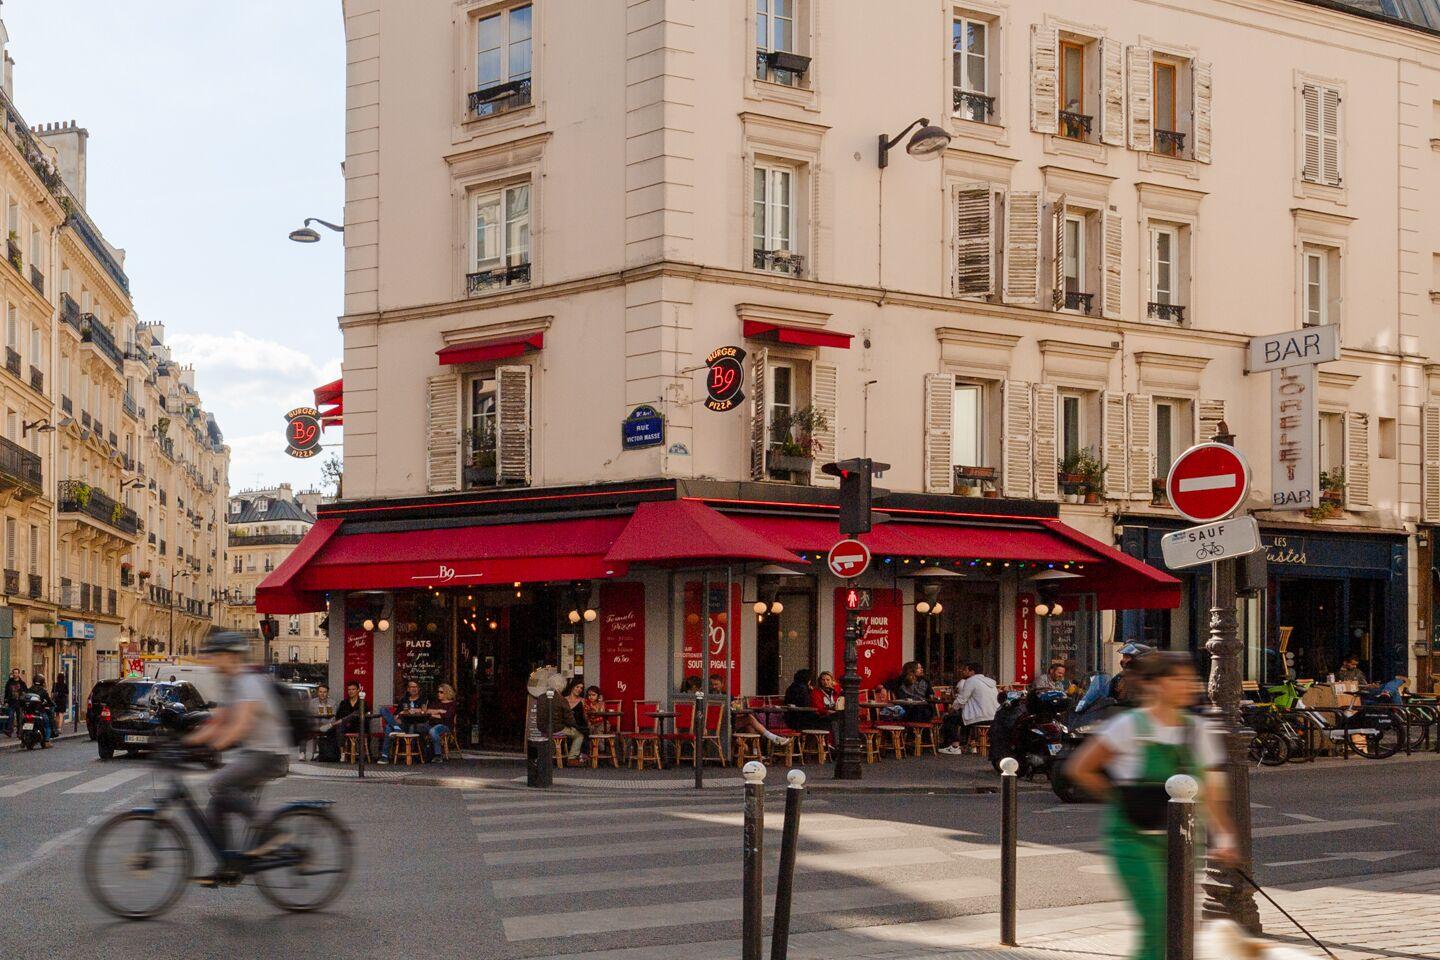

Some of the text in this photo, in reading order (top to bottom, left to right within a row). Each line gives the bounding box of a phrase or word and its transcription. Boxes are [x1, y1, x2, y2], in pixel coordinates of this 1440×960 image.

[1265, 333, 1320, 363] BAR
[707, 347, 737, 362] BURGER
[711, 366, 735, 394] B9
[709, 400, 732, 410] PIZZA
[288, 407, 317, 418] BURGER
[291, 421, 317, 444] B9
[626, 435, 643, 443] VICTOR
[291, 449, 314, 458] PIZZA
[1273, 489, 1311, 505] BAR
[1188, 525, 1225, 542] SAUF
[1274, 536, 1287, 547] LES
[439, 565, 455, 583] B9
[870, 616, 888, 626] HOUR
[405, 640, 431, 648] PLATS
[687, 660, 703, 669] SOUT
[617, 680, 627, 692] B9
